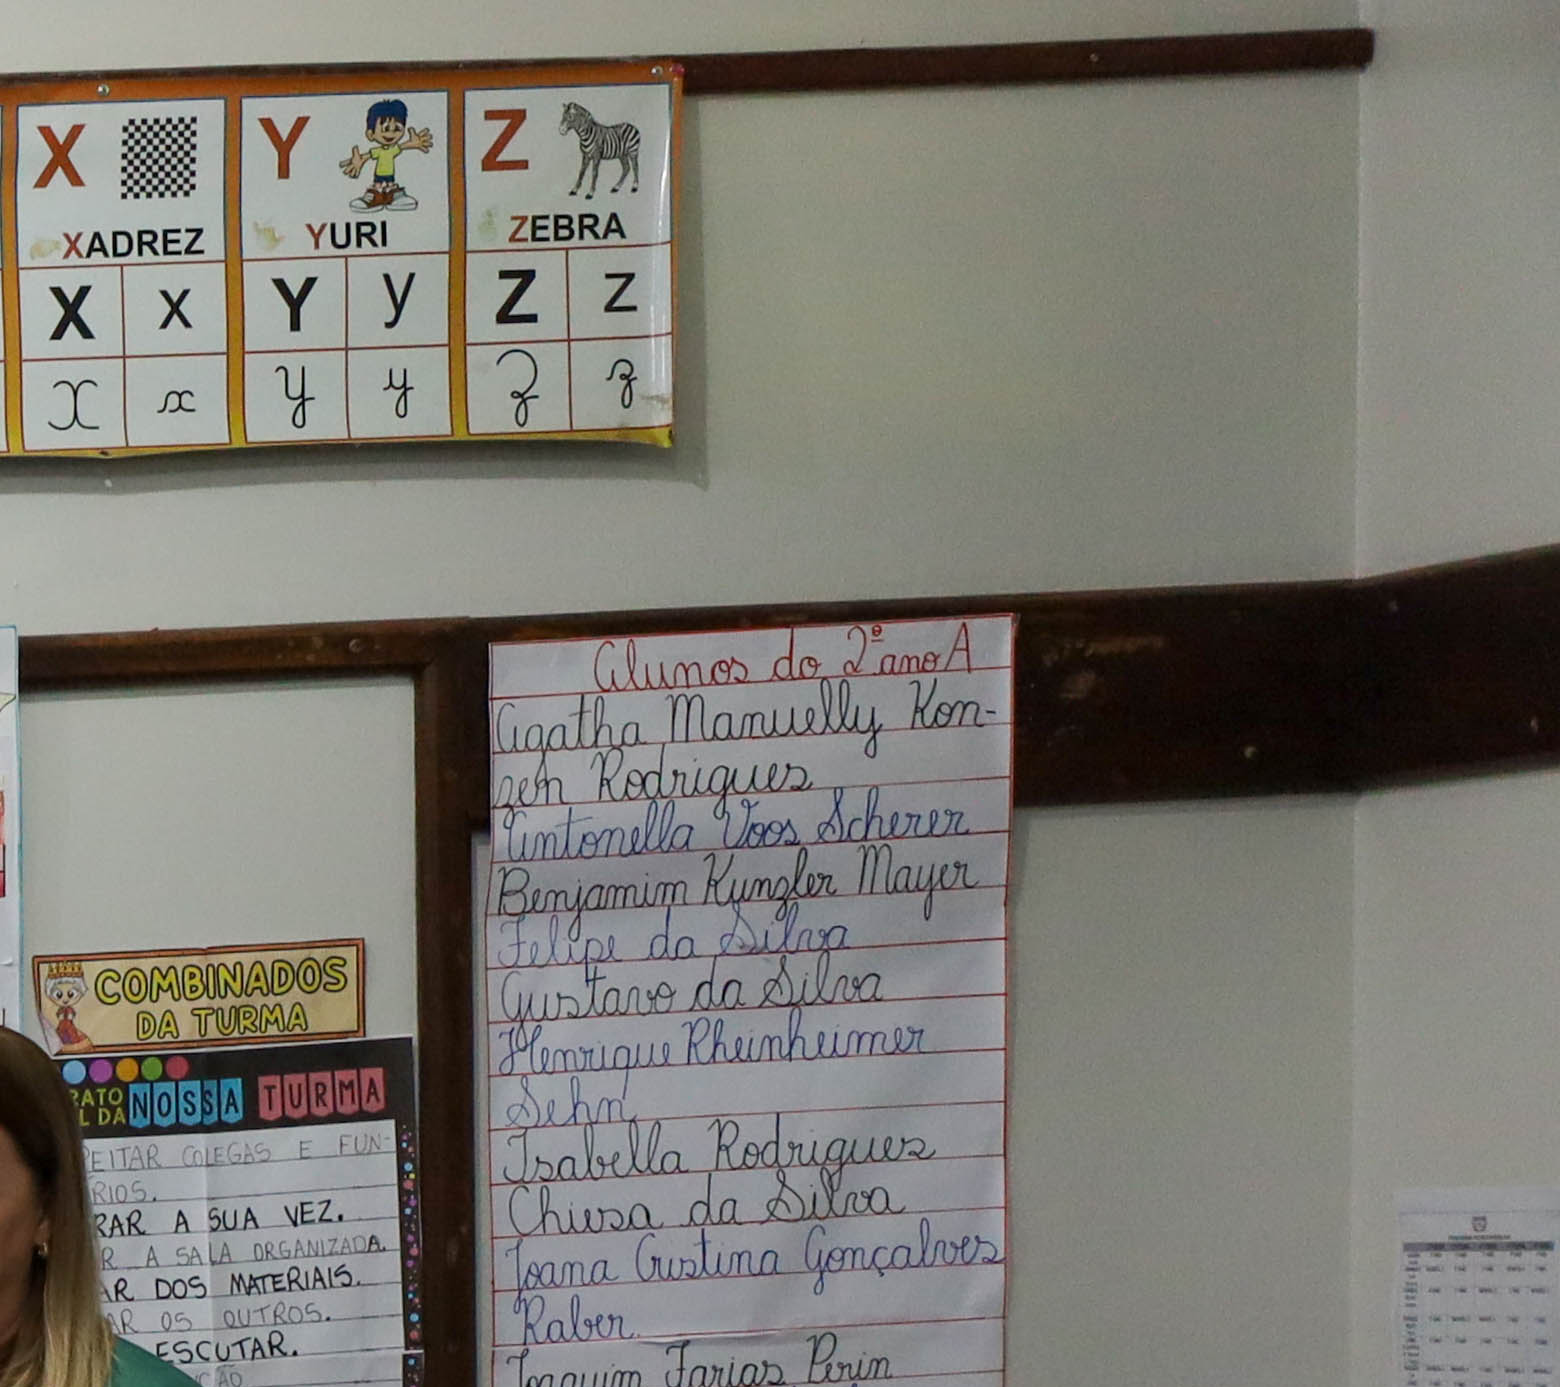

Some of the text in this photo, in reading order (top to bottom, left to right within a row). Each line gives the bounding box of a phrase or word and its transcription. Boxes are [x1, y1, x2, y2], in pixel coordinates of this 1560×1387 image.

[60, 227, 206, 263] XADREZ
[303, 219, 390, 252] YURI
[507, 212, 627, 246] ZEBRA
[594, 640, 747, 693] Alunos
[769, 627, 822, 681] do
[875, 645, 942, 675] ano
[944, 622, 971, 673] A
[498, 900, 850, 968] Felipe da Silva
[94, 956, 347, 1004] COMBINADOS
[137, 1002, 308, 1041] DA TURMA
[130, 1080, 382, 1120] NOSSA TURMA
[181, 1141, 272, 1166] COLEGAS
[173, 1200, 345, 1234] A SUA VEZ.
[176, 1242, 233, 1266] SALA
[156, 1265, 361, 1301] DOS MATERIAIS.
